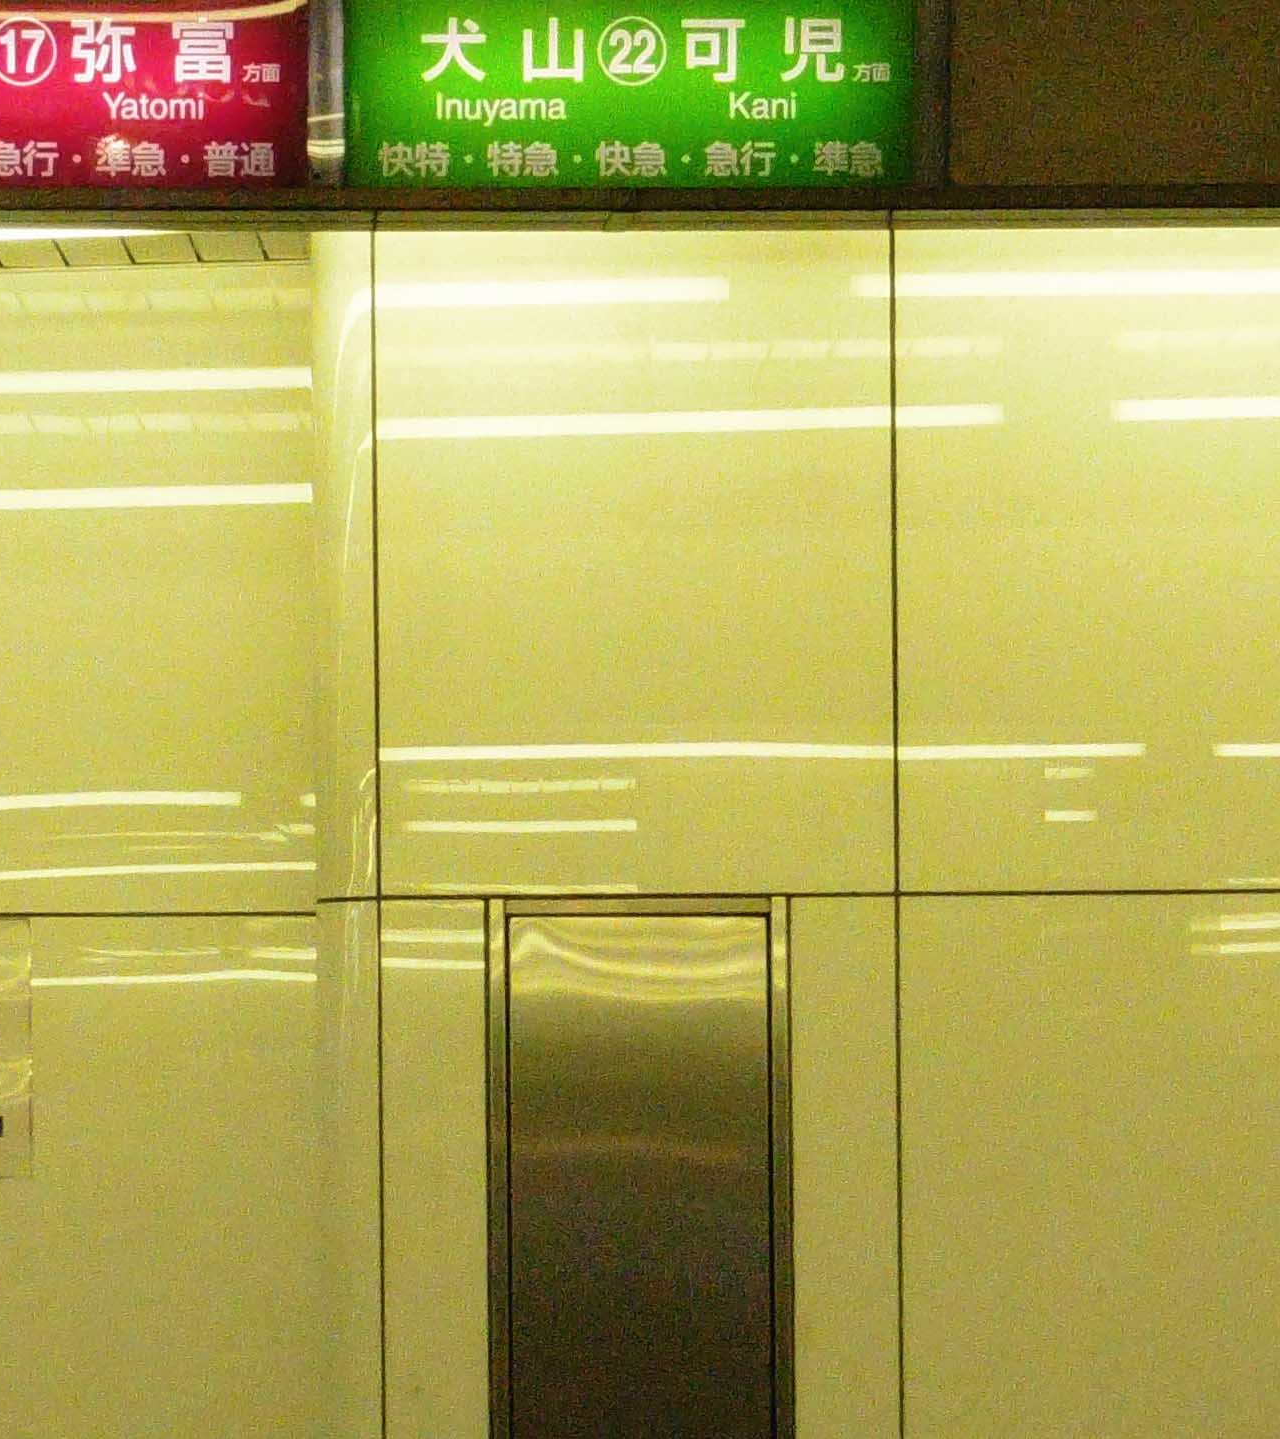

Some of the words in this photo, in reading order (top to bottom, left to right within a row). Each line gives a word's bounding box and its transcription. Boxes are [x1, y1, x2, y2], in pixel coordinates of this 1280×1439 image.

[70, 17, 235, 84] 弥富
[241, 63, 281, 83] 方面
[420, 17, 585, 83] 犬山
[680, 16, 846, 83] 可児
[102, 90, 205, 121] Yatomi
[435, 91, 567, 127] Inuyama
[728, 90, 798, 121] Kani
